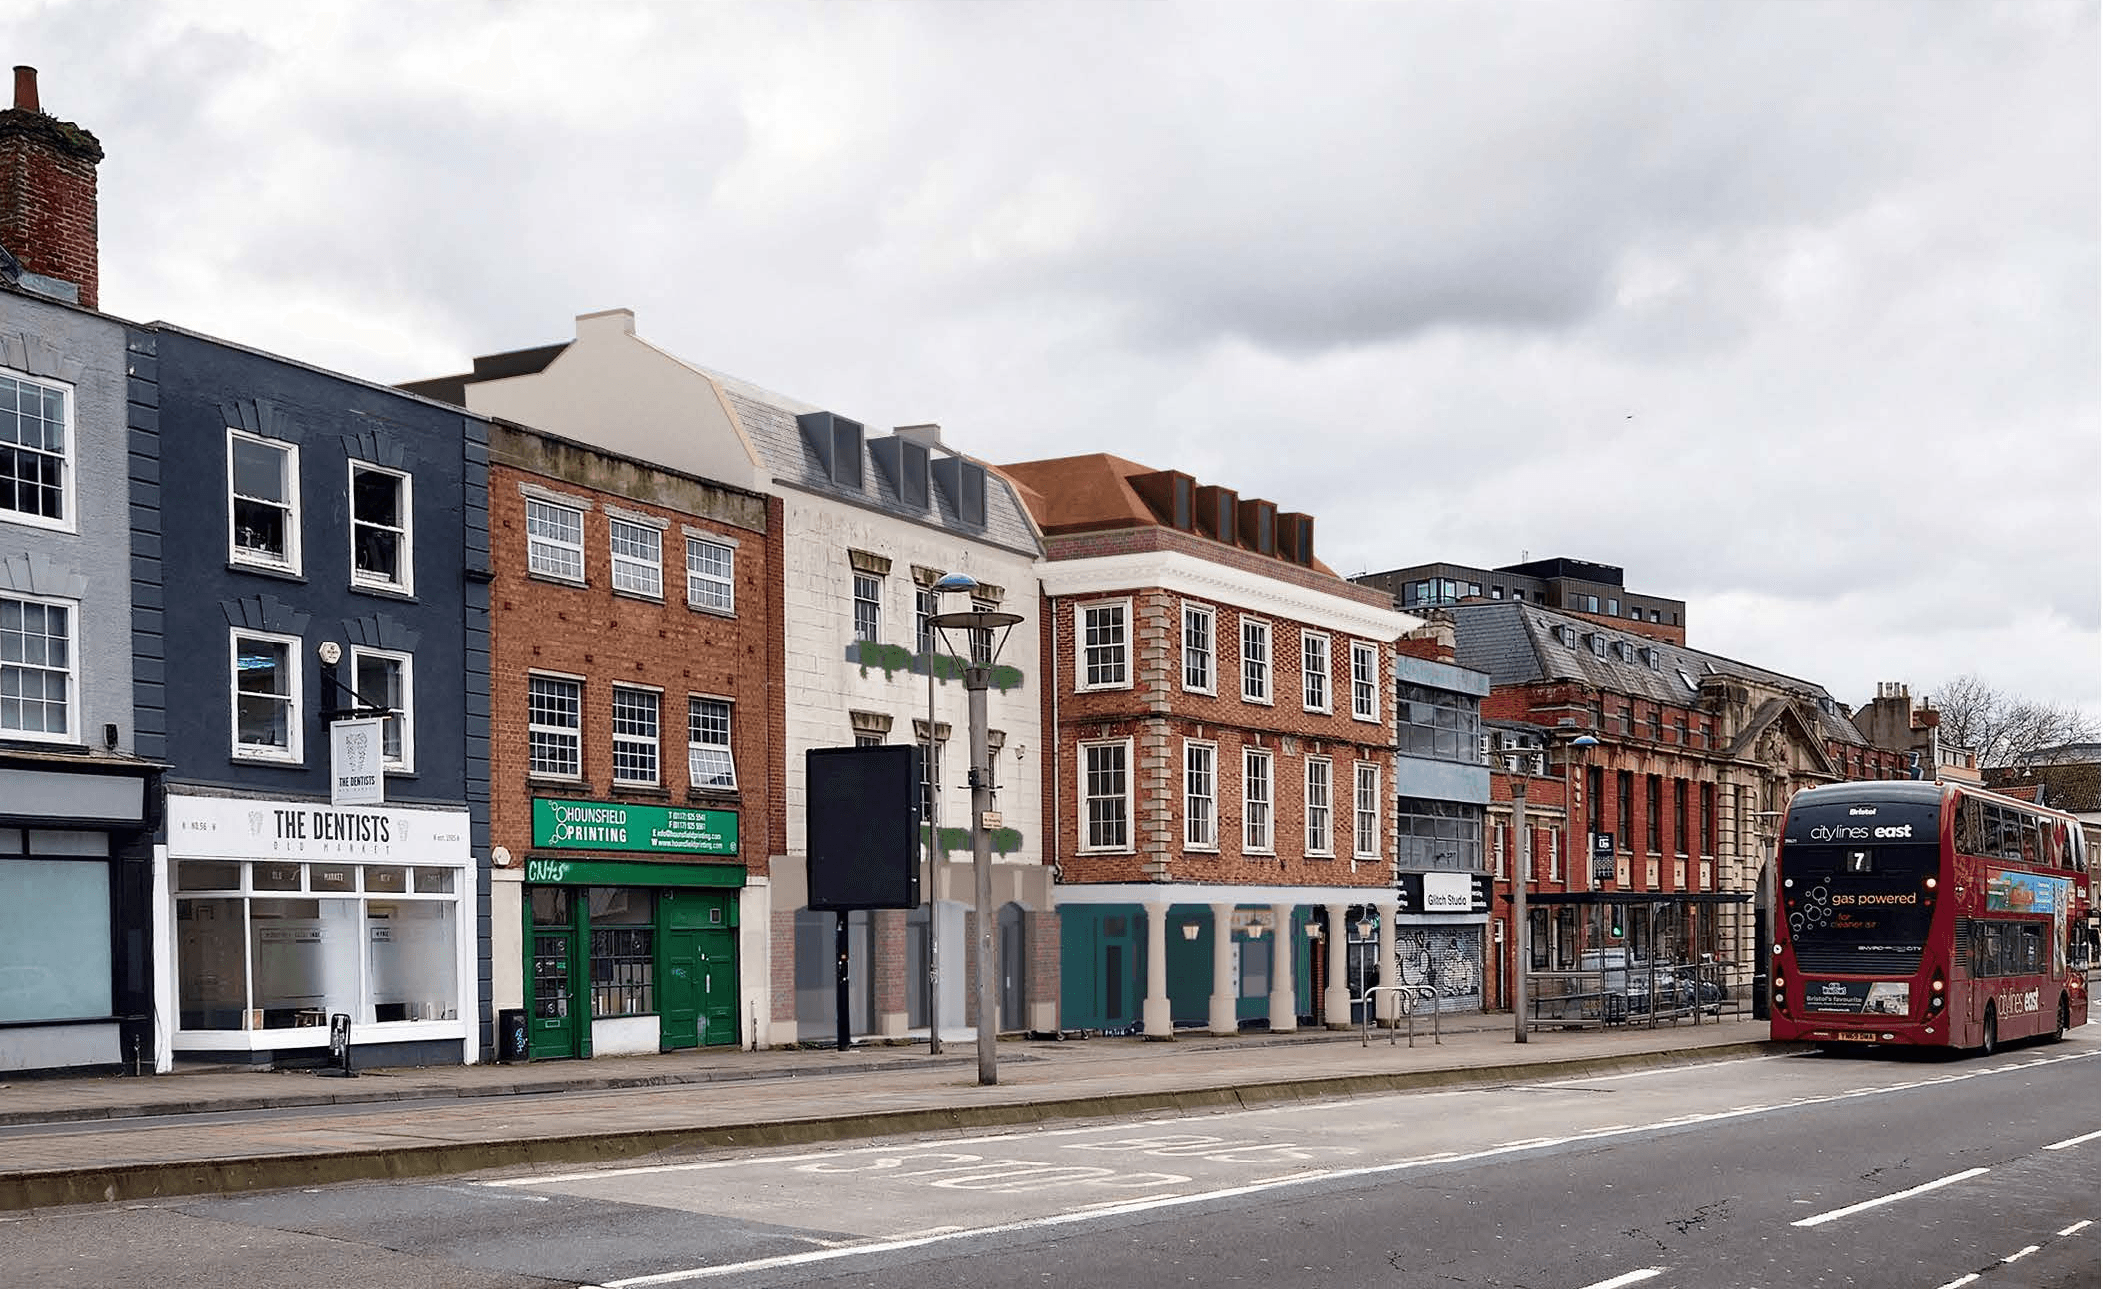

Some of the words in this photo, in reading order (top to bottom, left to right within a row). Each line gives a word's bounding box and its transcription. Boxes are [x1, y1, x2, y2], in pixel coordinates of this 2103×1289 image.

[339, 777, 349, 787] THE
[350, 775, 376, 787] DENTISTS
[567, 806, 627, 825] HOUNSFIELD
[1849, 807, 1877, 816] Bristol
[273, 810, 306, 839] THE
[313, 811, 390, 843] DENTISTS
[567, 825, 627, 843] PRINTING
[1810, 824, 1869, 842] citylines
[1874, 824, 1913, 838] east
[1854, 852, 1865, 871] 7
[1428, 894, 1447, 906] Glitch
[1832, 894, 1856, 906] gas
[1858, 892, 1917, 906] powered
[2024, 985, 2039, 1012] east
